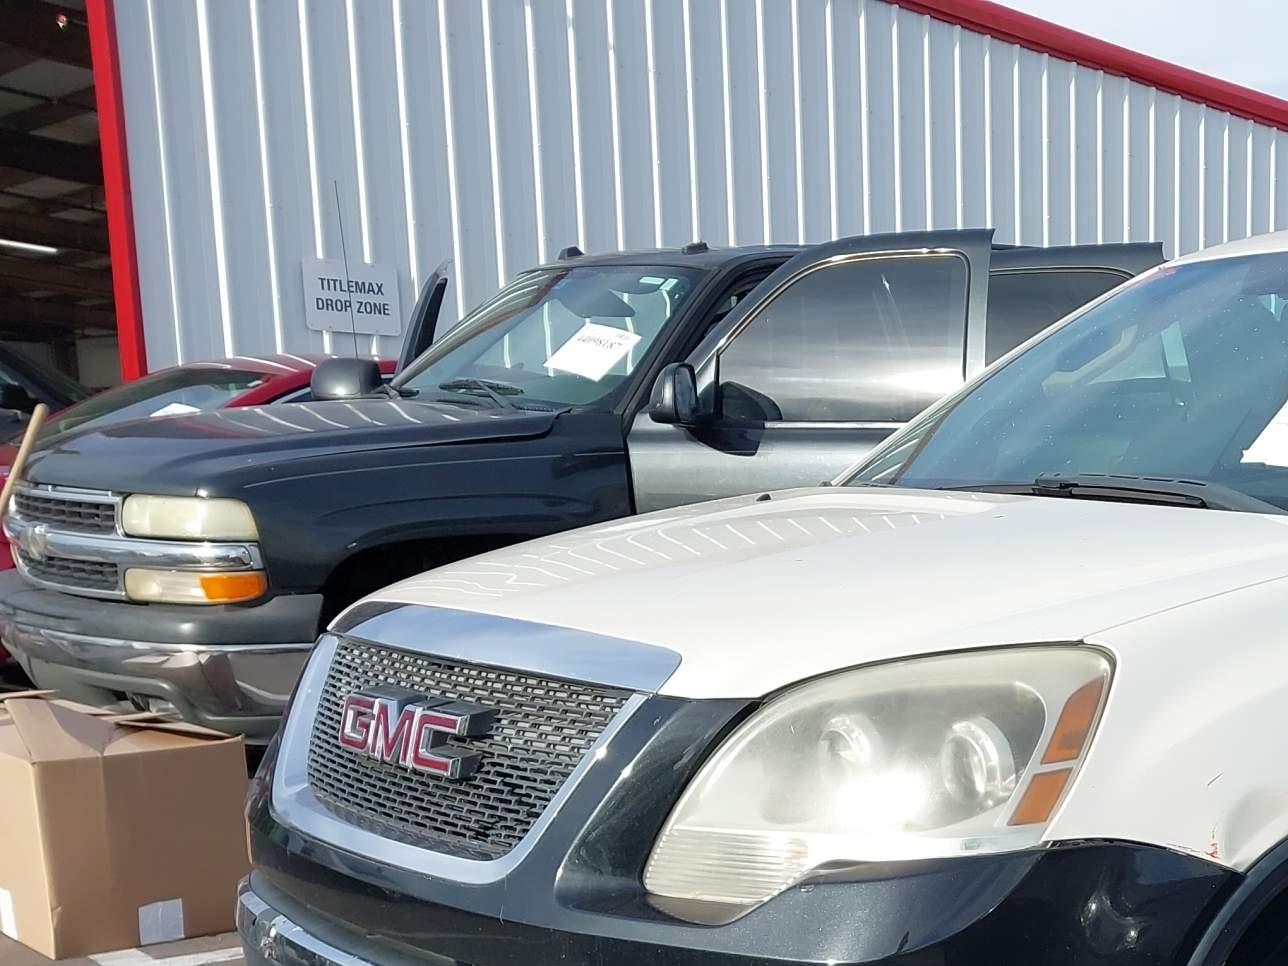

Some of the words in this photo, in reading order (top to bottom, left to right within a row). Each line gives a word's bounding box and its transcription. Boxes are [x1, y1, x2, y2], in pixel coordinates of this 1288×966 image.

[318, 277, 384, 296] TITLEMAX
[316, 297, 351, 312] DROP
[356, 301, 390, 316] ZONE
[339, 695, 470, 778] GMC
